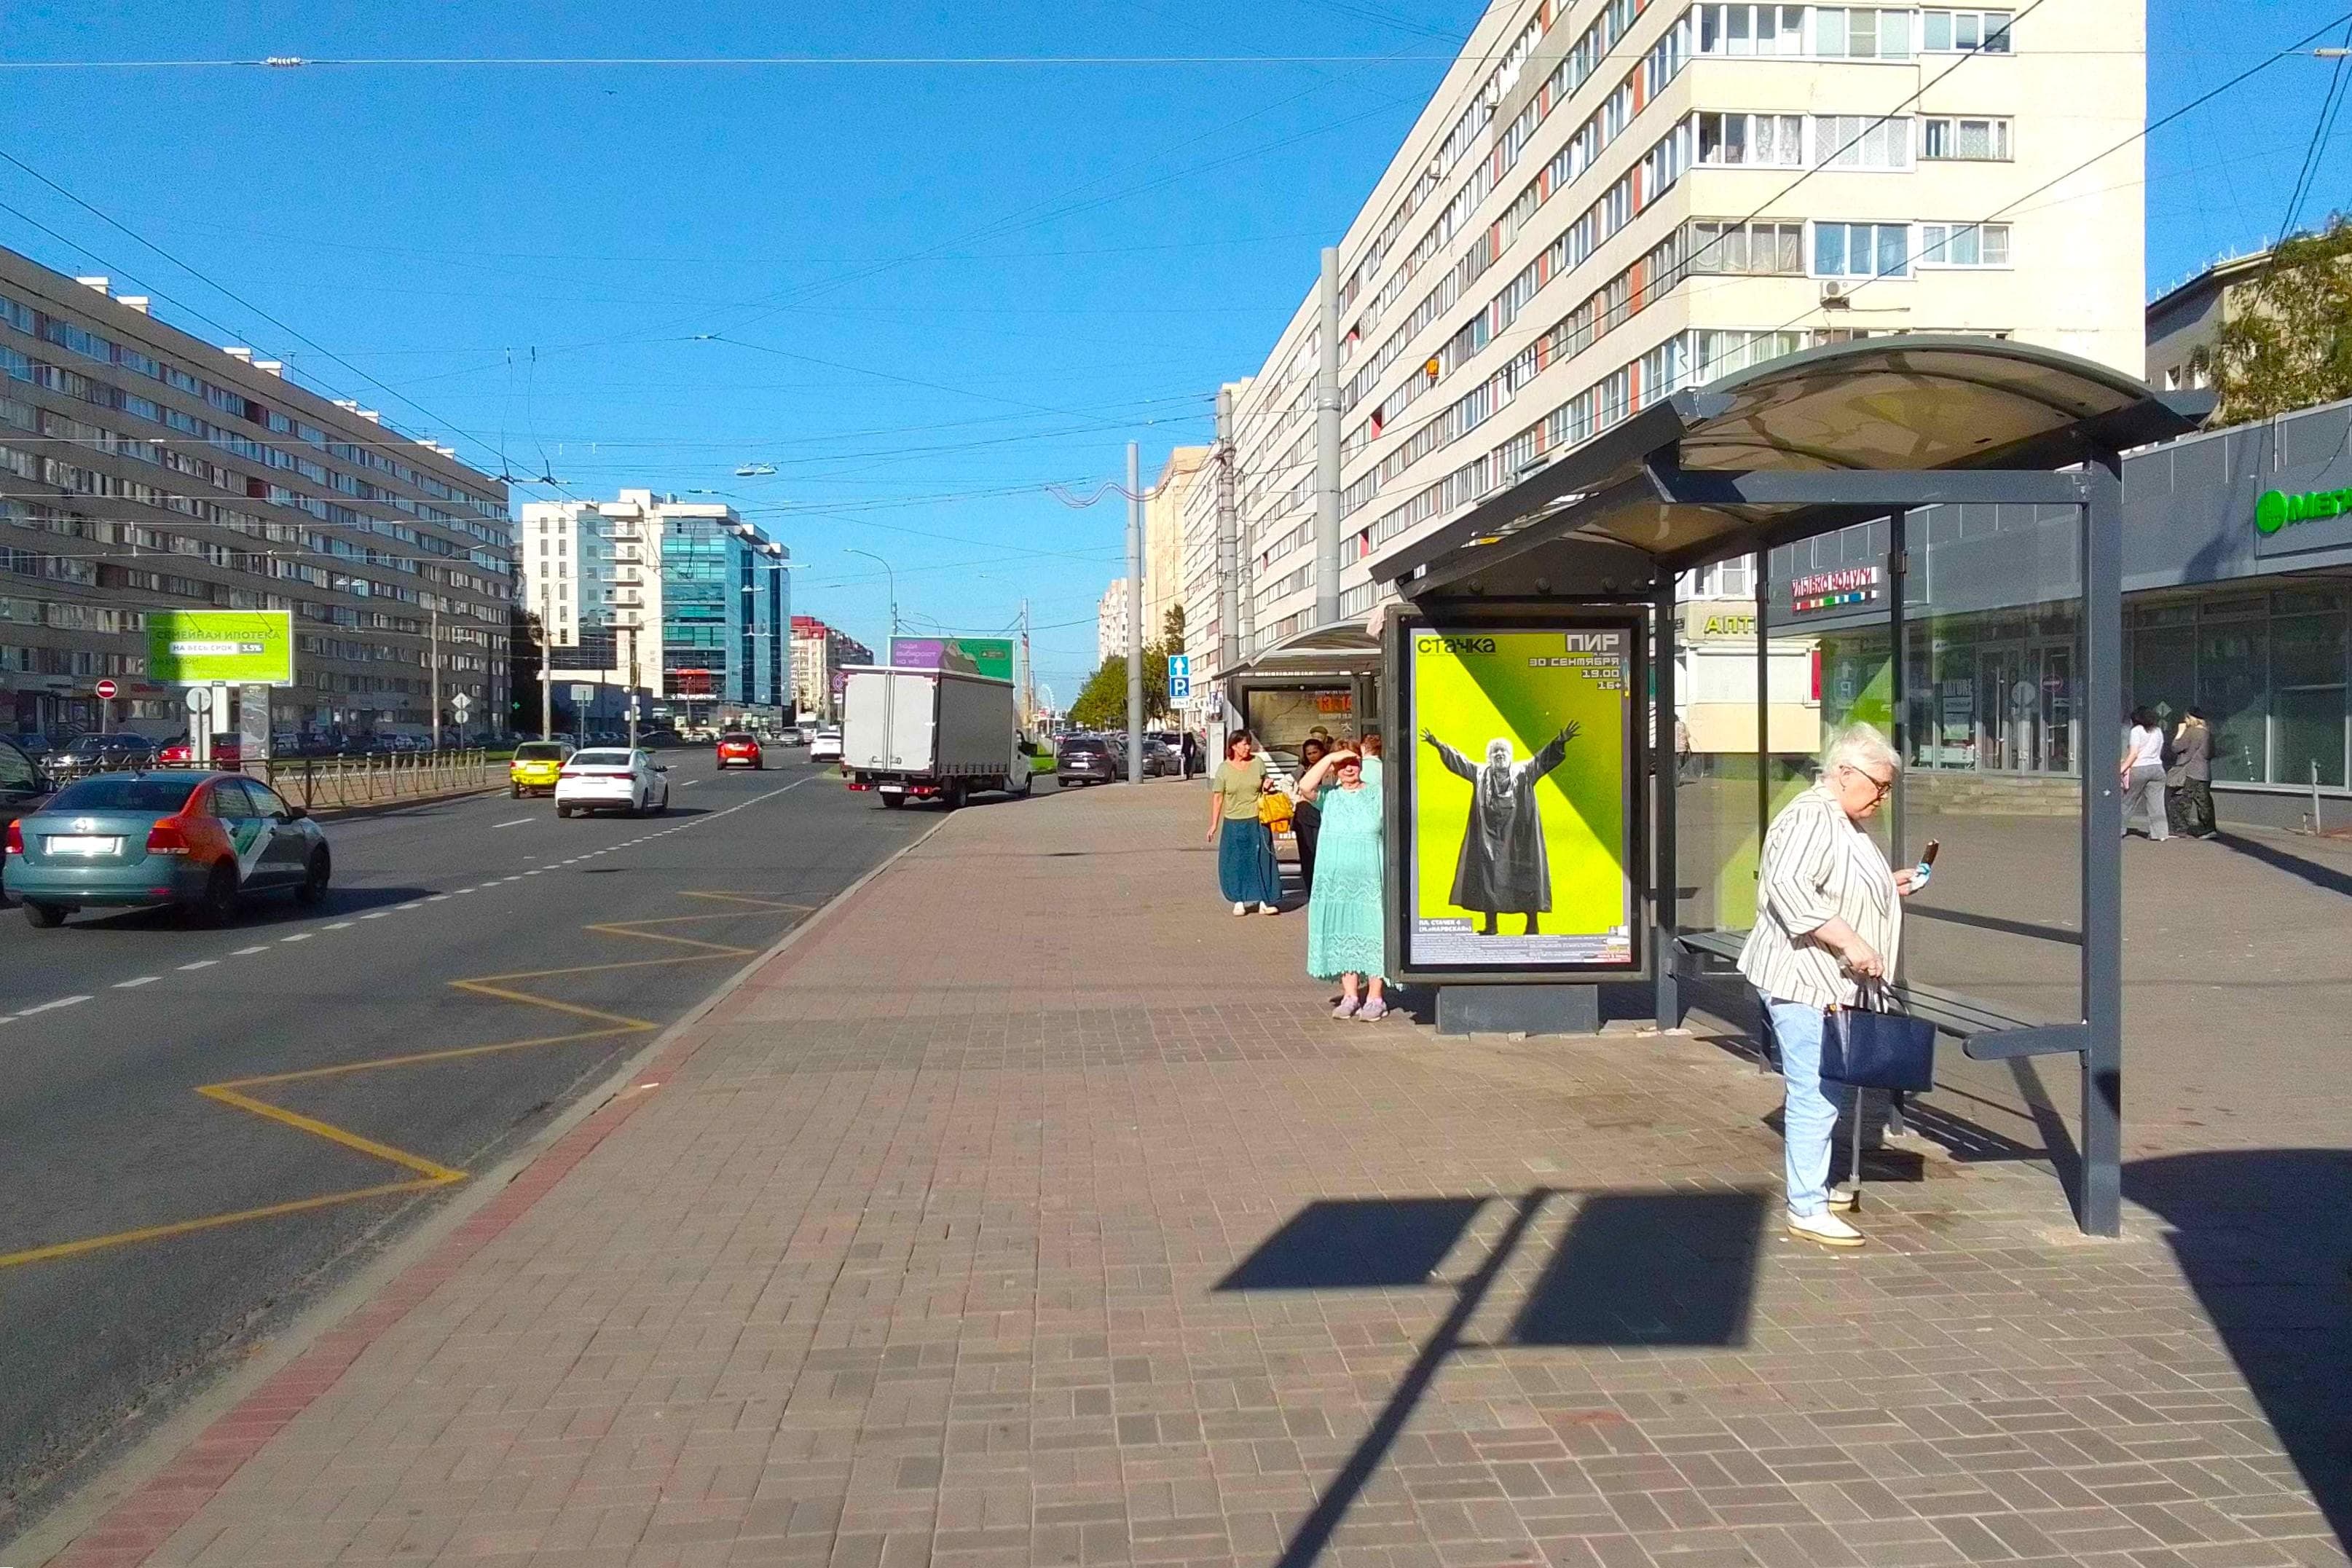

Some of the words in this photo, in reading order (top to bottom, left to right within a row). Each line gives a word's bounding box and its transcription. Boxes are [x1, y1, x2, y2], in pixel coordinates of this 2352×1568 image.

[1704, 615, 1758, 634] АПТ
[157, 630, 221, 640] СЕМЕЙНАЯ
[224, 630, 281, 640] ИПОТЕКА
[1567, 634, 1619, 652] ПИР
[1551, 657, 1619, 666] СЕНТЯБРЯ
[1582, 669, 1619, 678] 19.00
[1597, 681, 1621, 690] 16+
